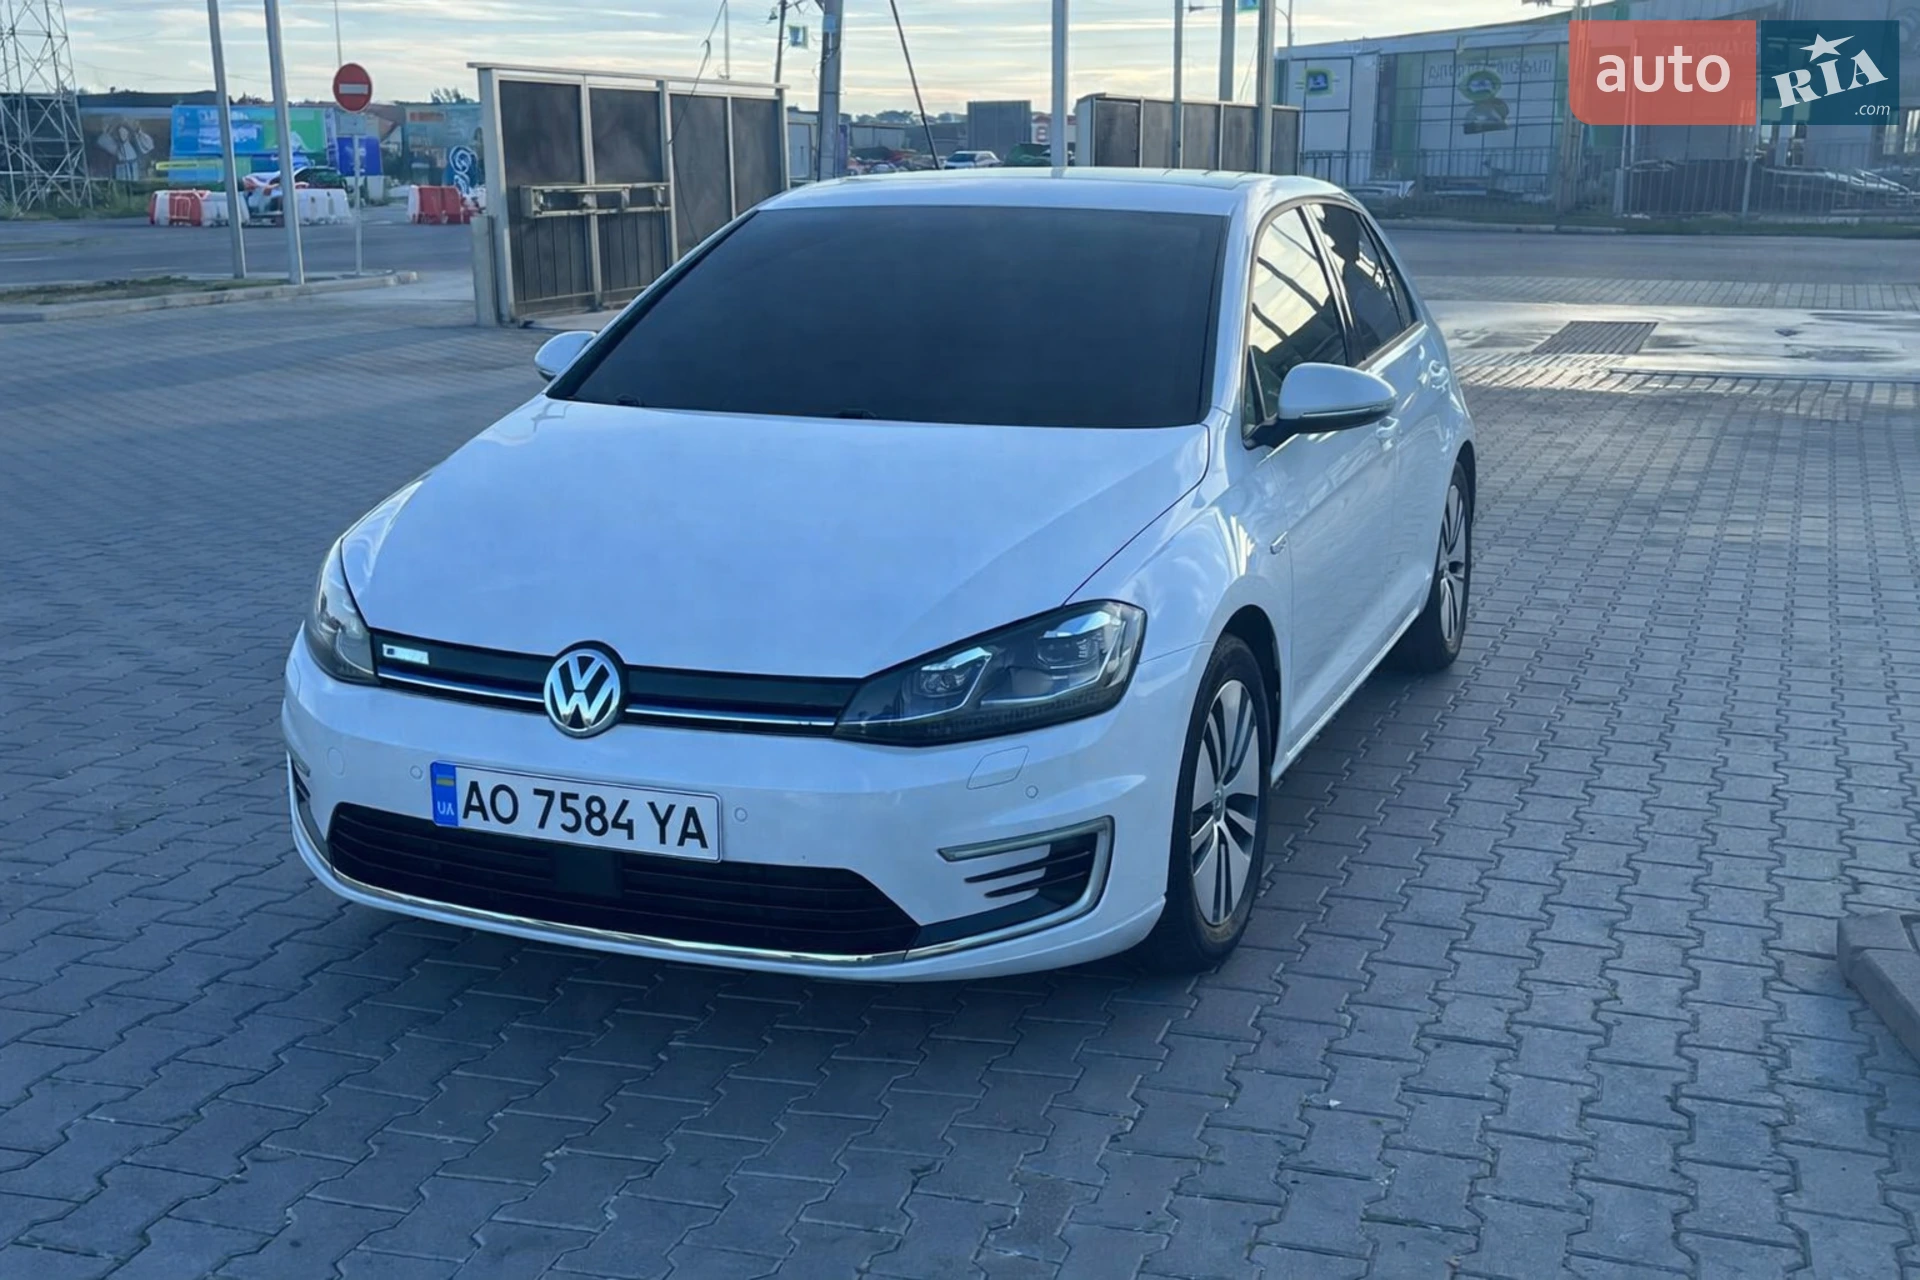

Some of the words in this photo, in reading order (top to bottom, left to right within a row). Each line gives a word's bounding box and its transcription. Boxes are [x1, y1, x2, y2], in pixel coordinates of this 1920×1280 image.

[437, 800, 455, 817] UA
[462, 780, 520, 826] AO
[533, 788, 635, 841] 7584
[645, 800, 709, 850] YA
